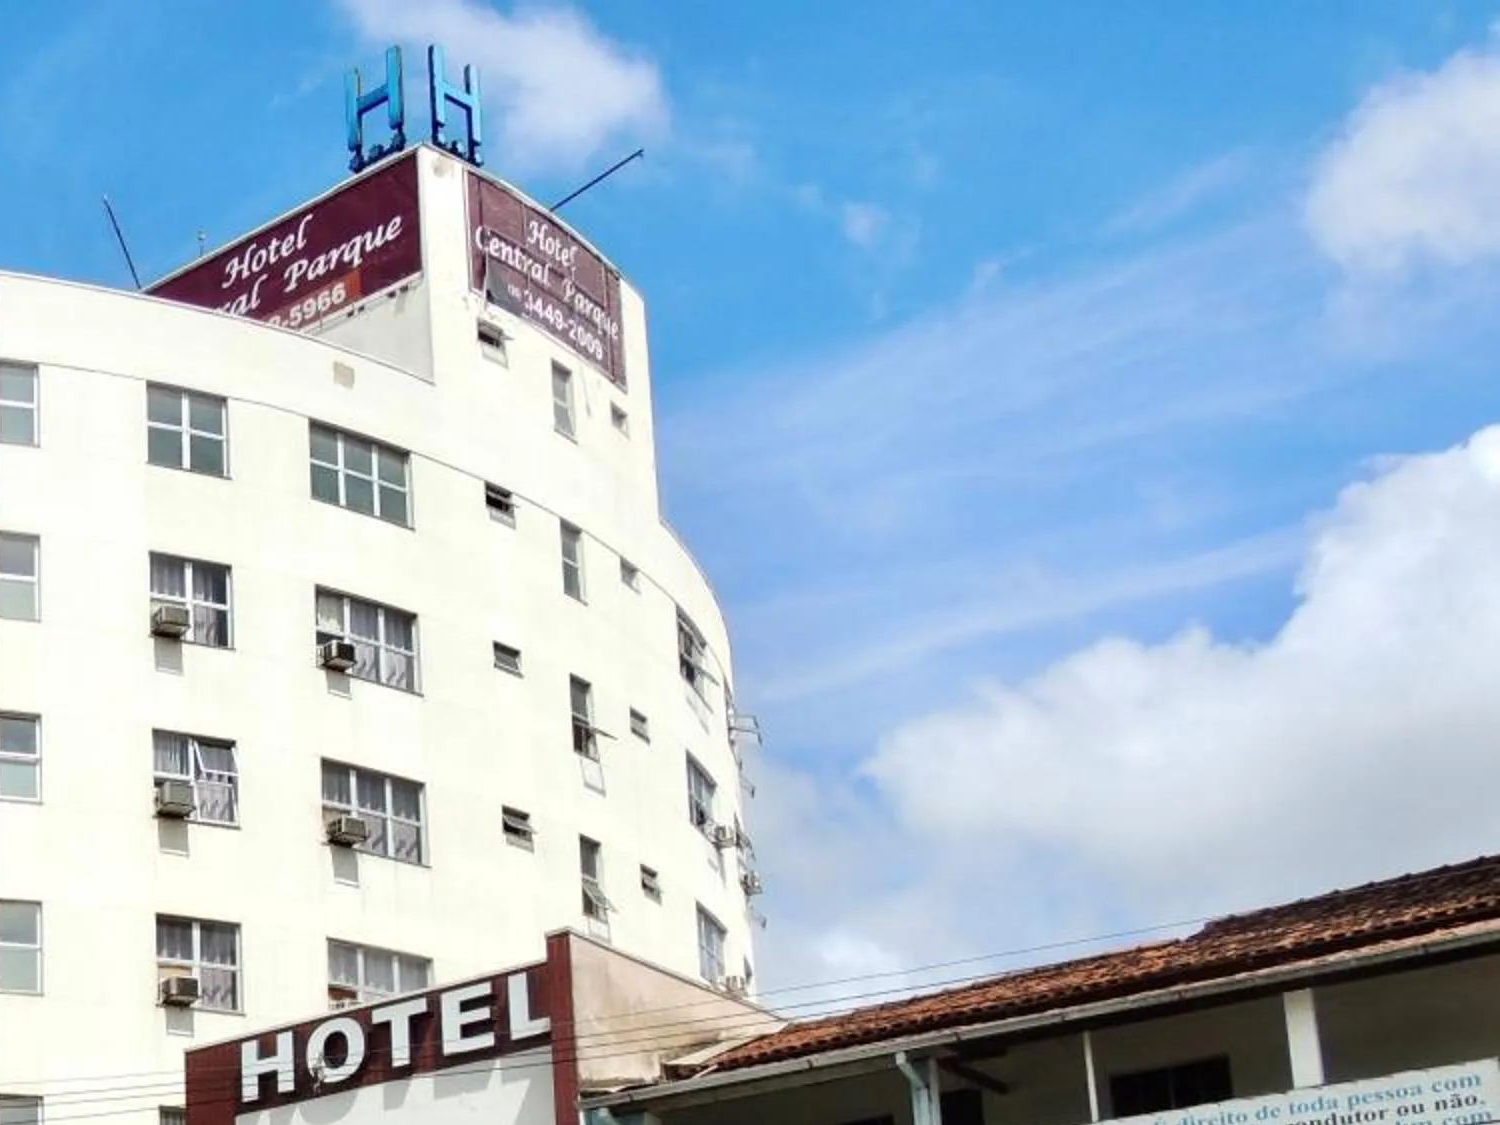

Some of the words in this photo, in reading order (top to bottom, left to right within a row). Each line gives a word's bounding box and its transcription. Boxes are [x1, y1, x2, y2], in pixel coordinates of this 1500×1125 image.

[221, 213, 314, 289] Hotel
[283, 215, 403, 293] Parque
[527, 220, 579, 267] Hotel
[475, 225, 551, 287] Central
[562, 277, 620, 341] Parque
[241, 972, 553, 1104] HOTEL
[1255, 1105, 1281, 1121] de
[1289, 1096, 1338, 1115] toda
[1347, 1084, 1422, 1110] pessoa
[1431, 1073, 1483, 1093] com
[1396, 1103, 1425, 1117] ou
